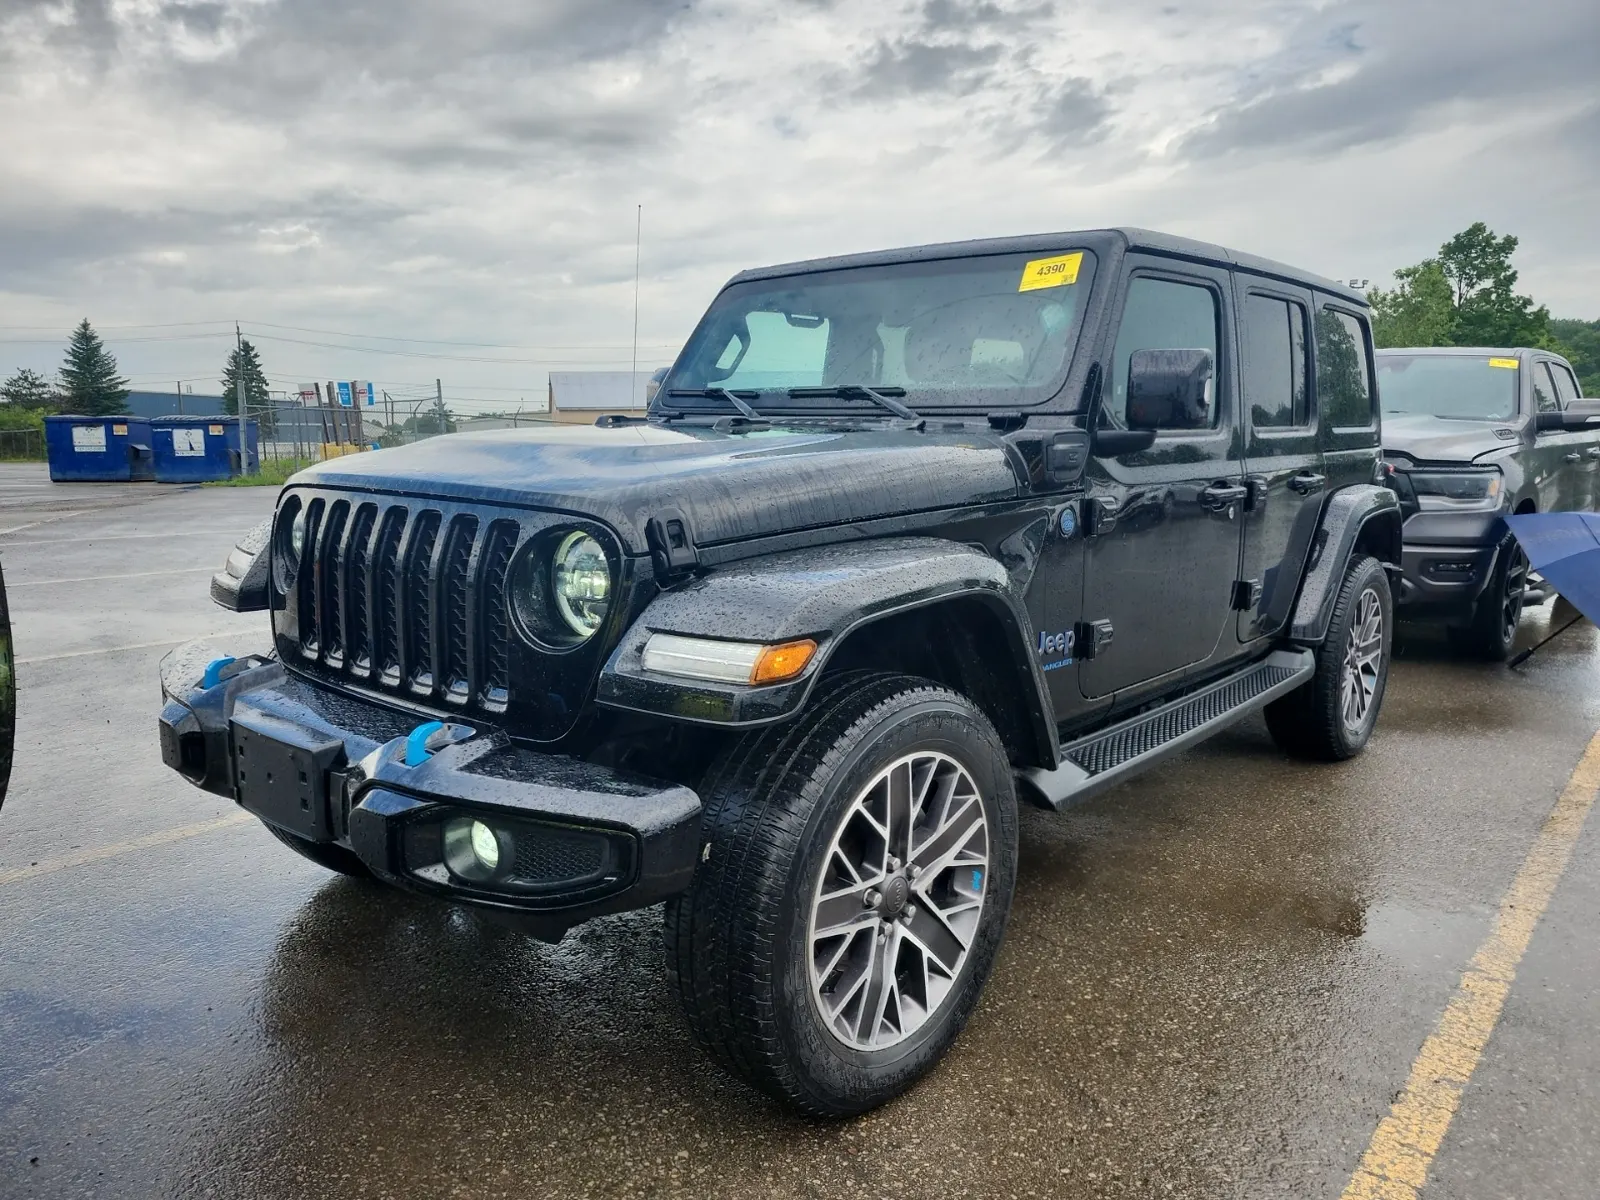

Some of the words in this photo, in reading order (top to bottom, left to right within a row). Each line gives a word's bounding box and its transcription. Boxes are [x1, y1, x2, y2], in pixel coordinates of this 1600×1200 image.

[1037, 263, 1066, 276] 4390
[1038, 630, 1075, 657] Jeep
[1042, 658, 1072, 672] ANGLER
